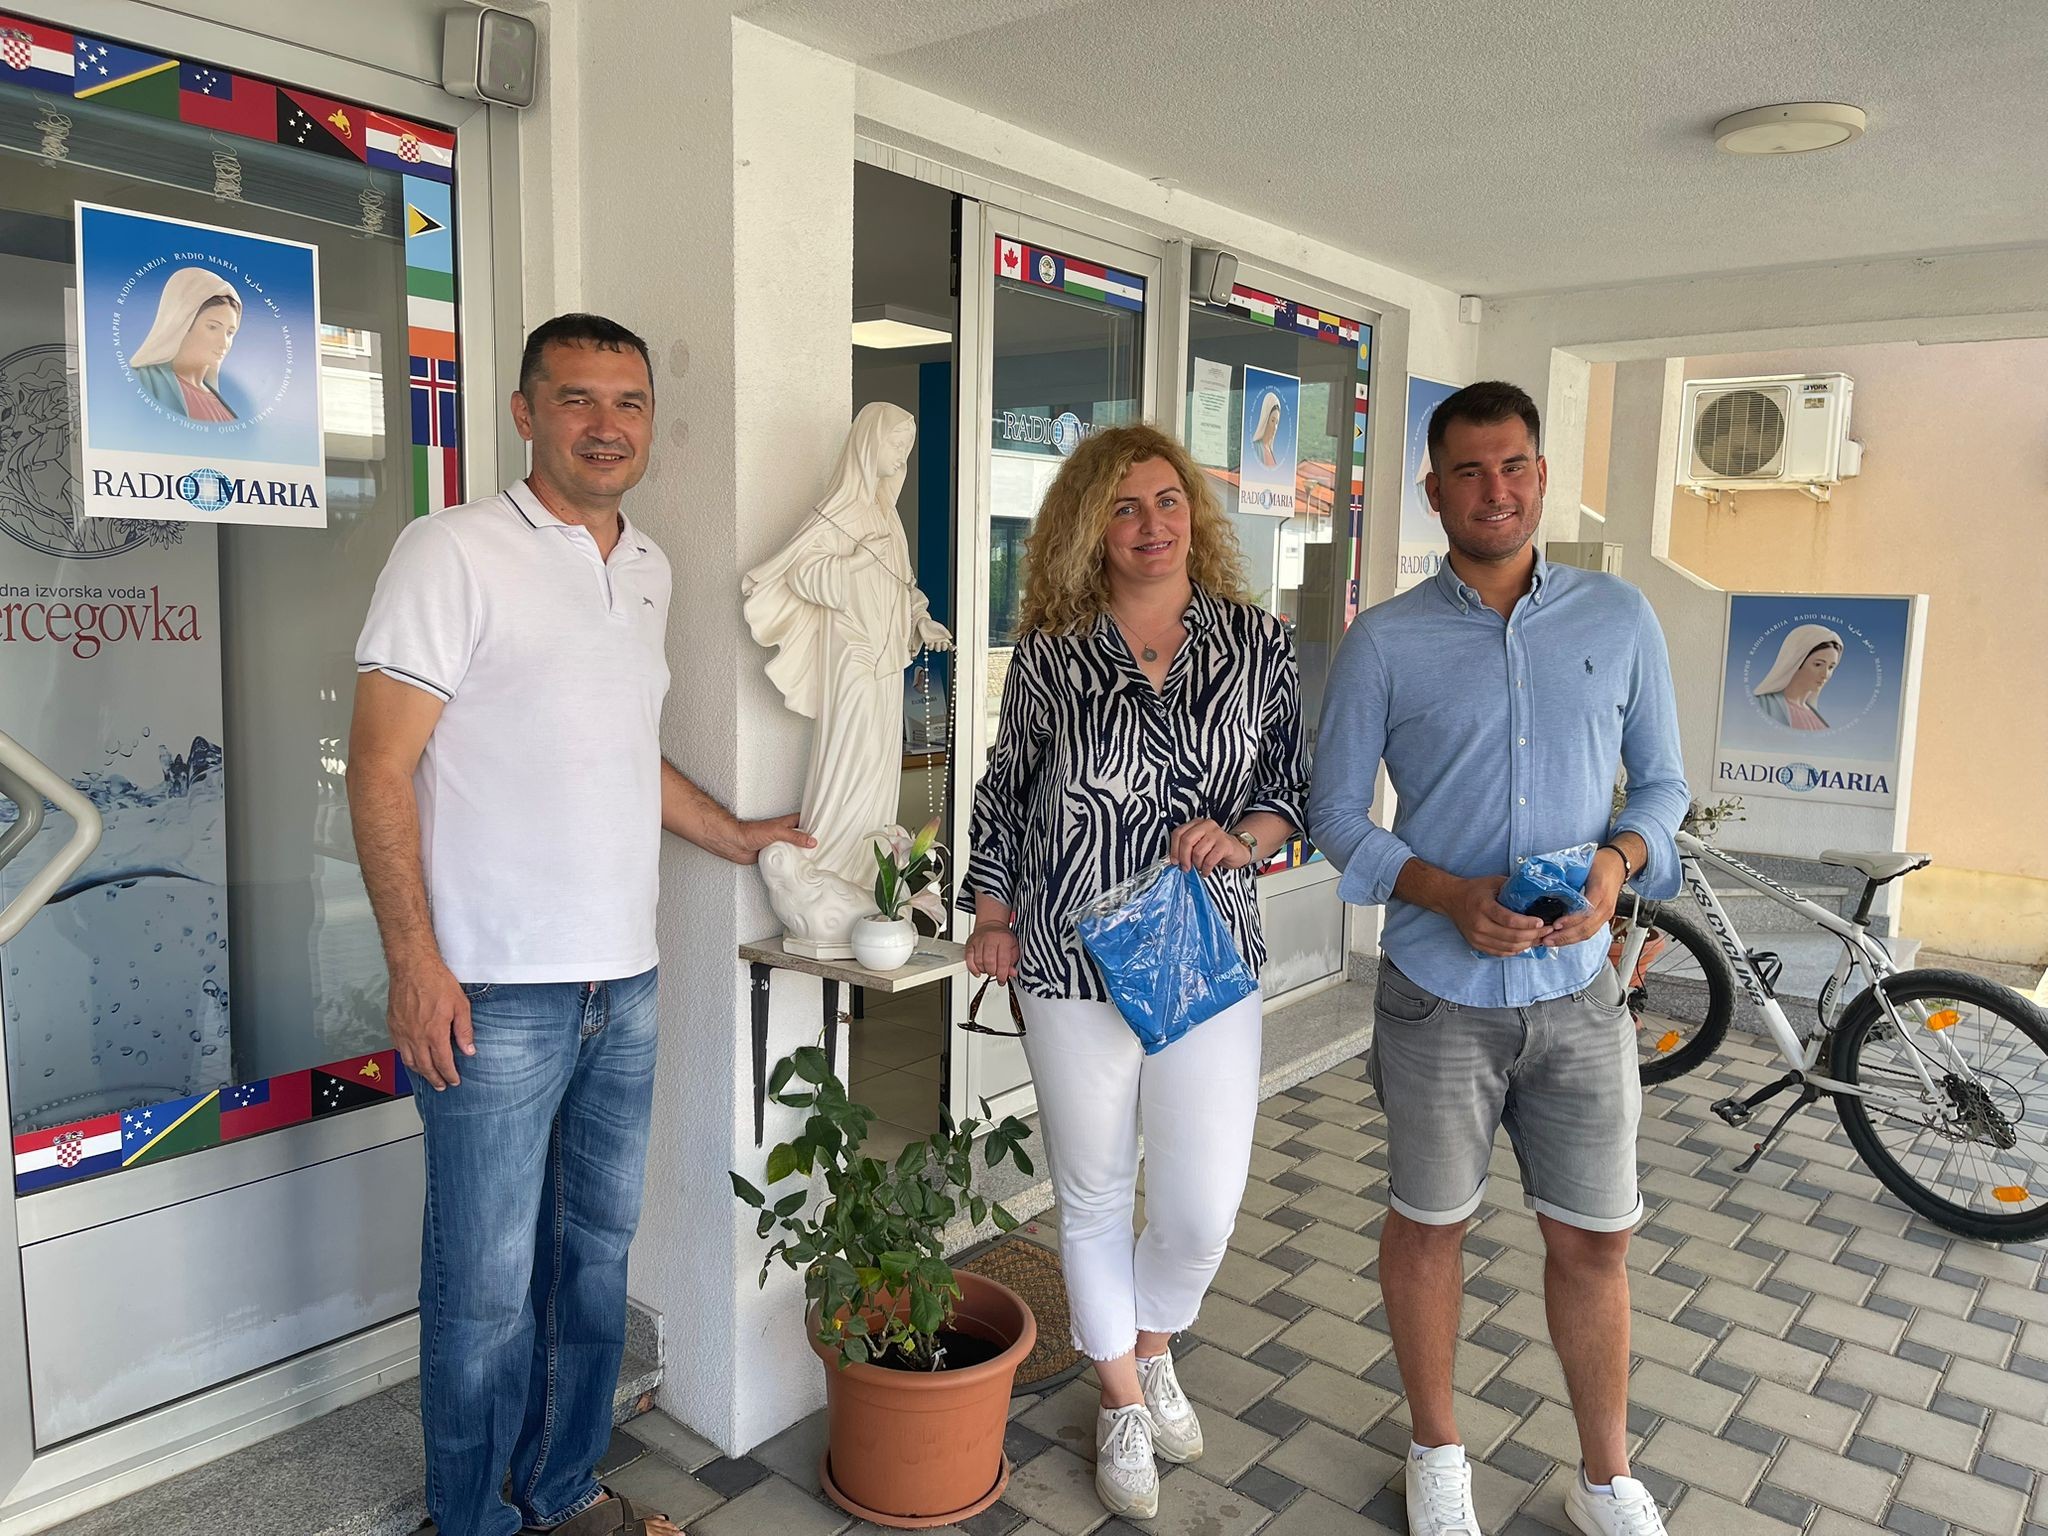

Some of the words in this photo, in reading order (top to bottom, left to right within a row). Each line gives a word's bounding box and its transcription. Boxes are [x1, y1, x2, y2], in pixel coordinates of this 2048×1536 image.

[173, 252, 204, 261] RADIO
[208, 255, 239, 274] MARIA
[116, 277, 137, 305] RADIO
[135, 256, 167, 279] MARIJA
[1002, 411, 1065, 446] RADIO
[92, 469, 200, 501] RADIO
[216, 476, 320, 509] MARIA
[1240, 490, 1265, 507] RADIO
[1268, 493, 1294, 508] MARIA
[1400, 555, 1430, 574] RADIO
[35, 584, 102, 598] izvorska
[108, 586, 146, 599] voda
[0, 585, 202, 659] rcegovka
[1718, 761, 1794, 786] RADIO
[1806, 767, 1890, 794] MARIA
[1687, 877, 1713, 908] KS
[1706, 912, 1766, 1008] CYCLING
